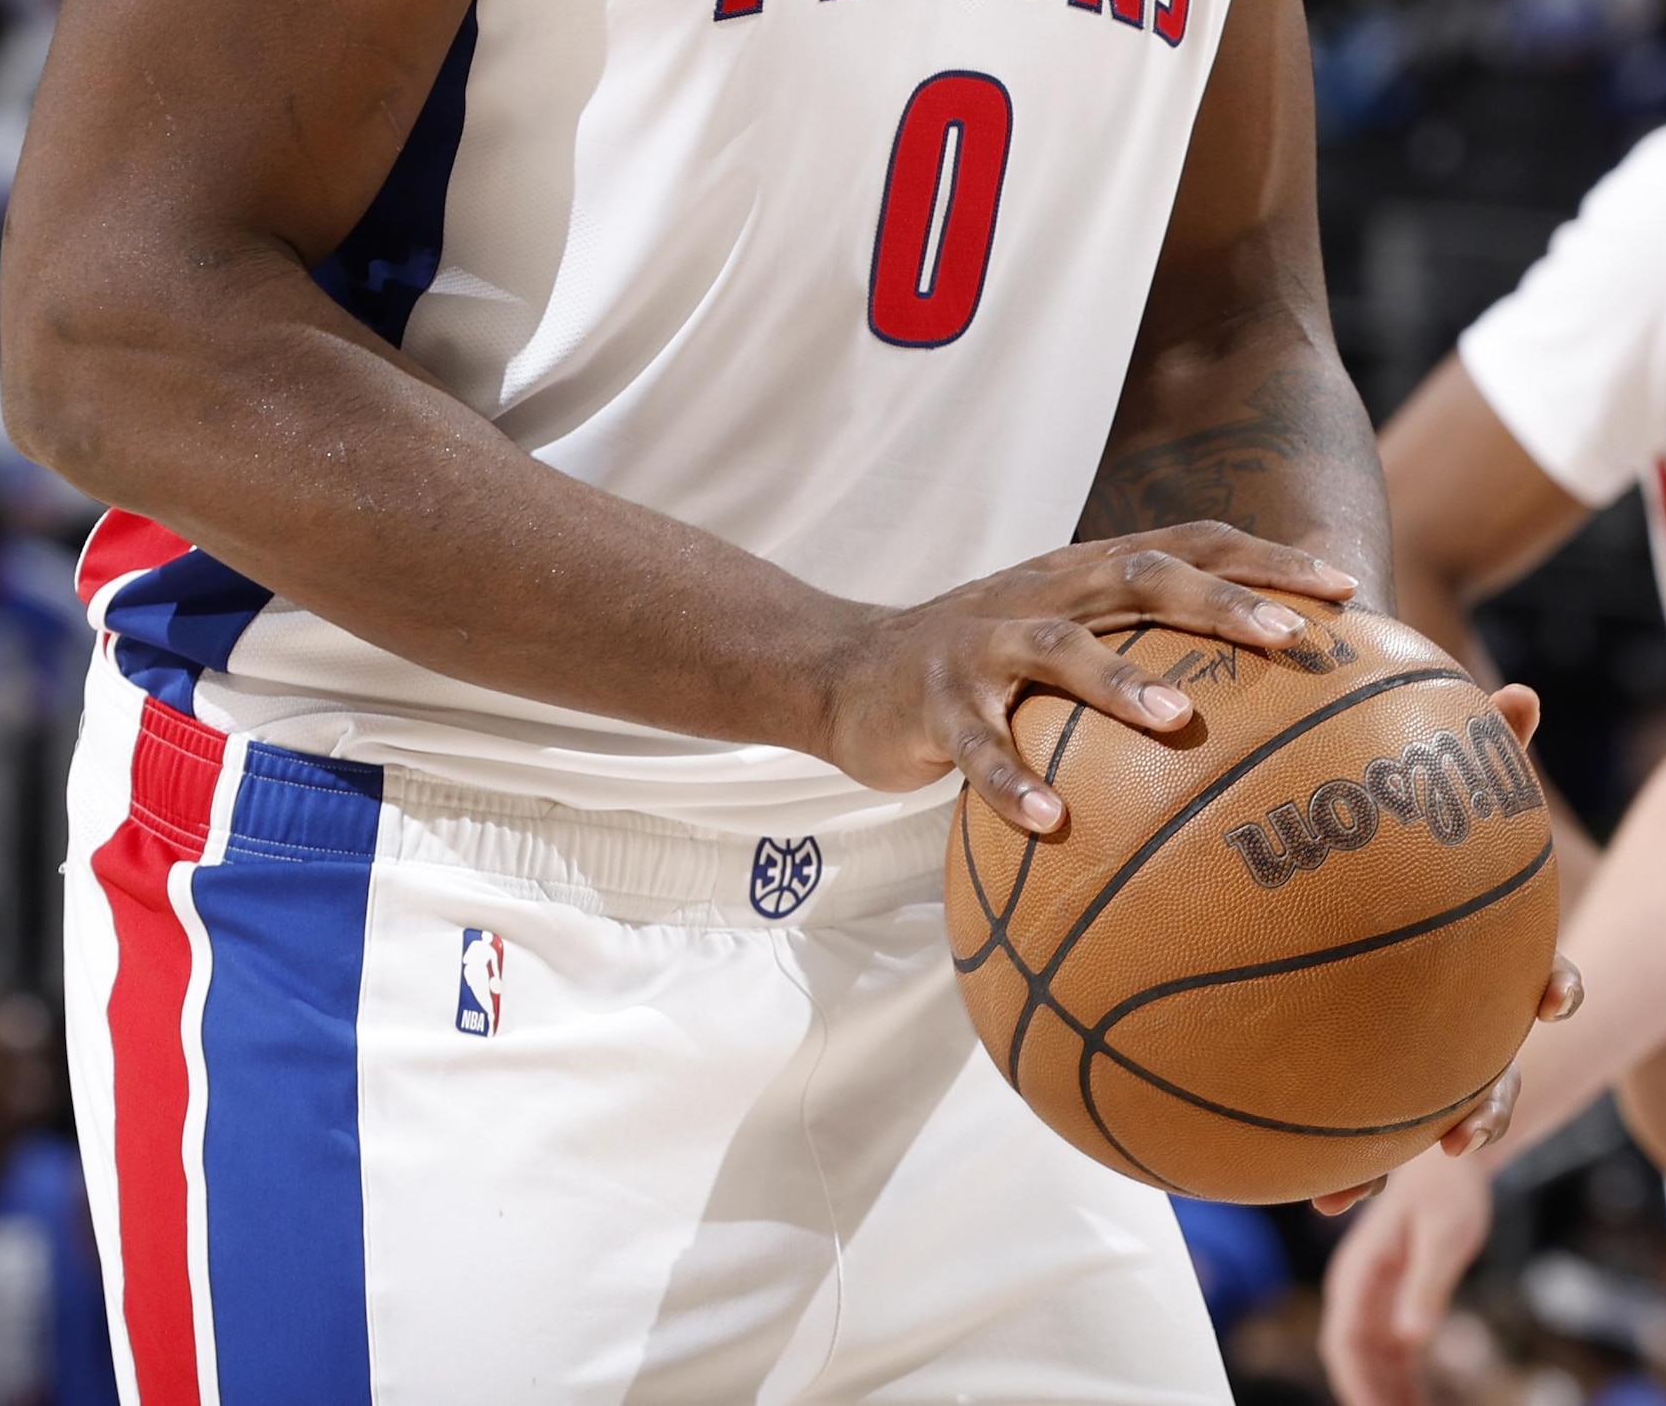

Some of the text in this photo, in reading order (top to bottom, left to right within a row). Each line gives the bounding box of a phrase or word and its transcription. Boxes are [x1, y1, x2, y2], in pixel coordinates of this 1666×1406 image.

[867, 69, 1015, 351] 0
[1223, 710, 1544, 890] Wilson
[460, 1008, 486, 1033] NBA
